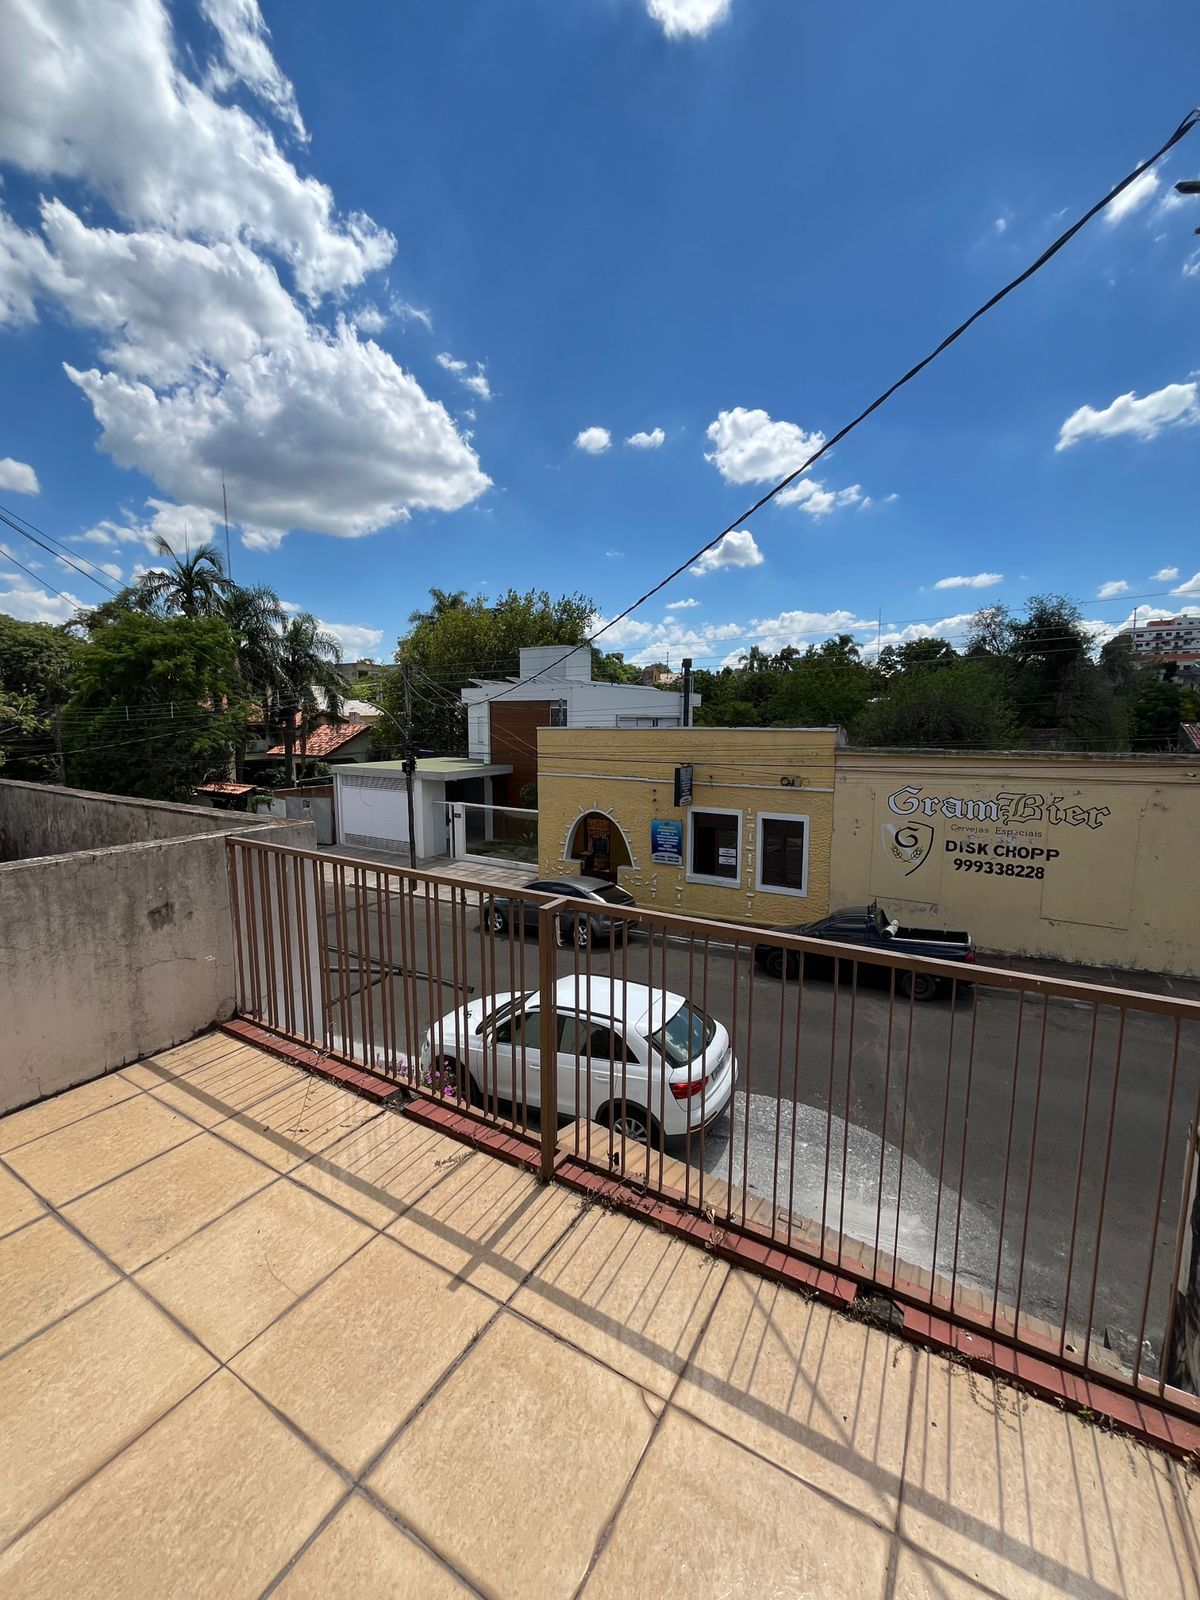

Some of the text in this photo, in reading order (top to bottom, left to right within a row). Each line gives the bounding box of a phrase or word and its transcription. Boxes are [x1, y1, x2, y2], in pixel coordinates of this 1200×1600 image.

[950, 824, 989, 834] Cervejas
[945, 840, 1060, 861] DISK CHOPP
[953, 858, 1045, 879] 999338228
